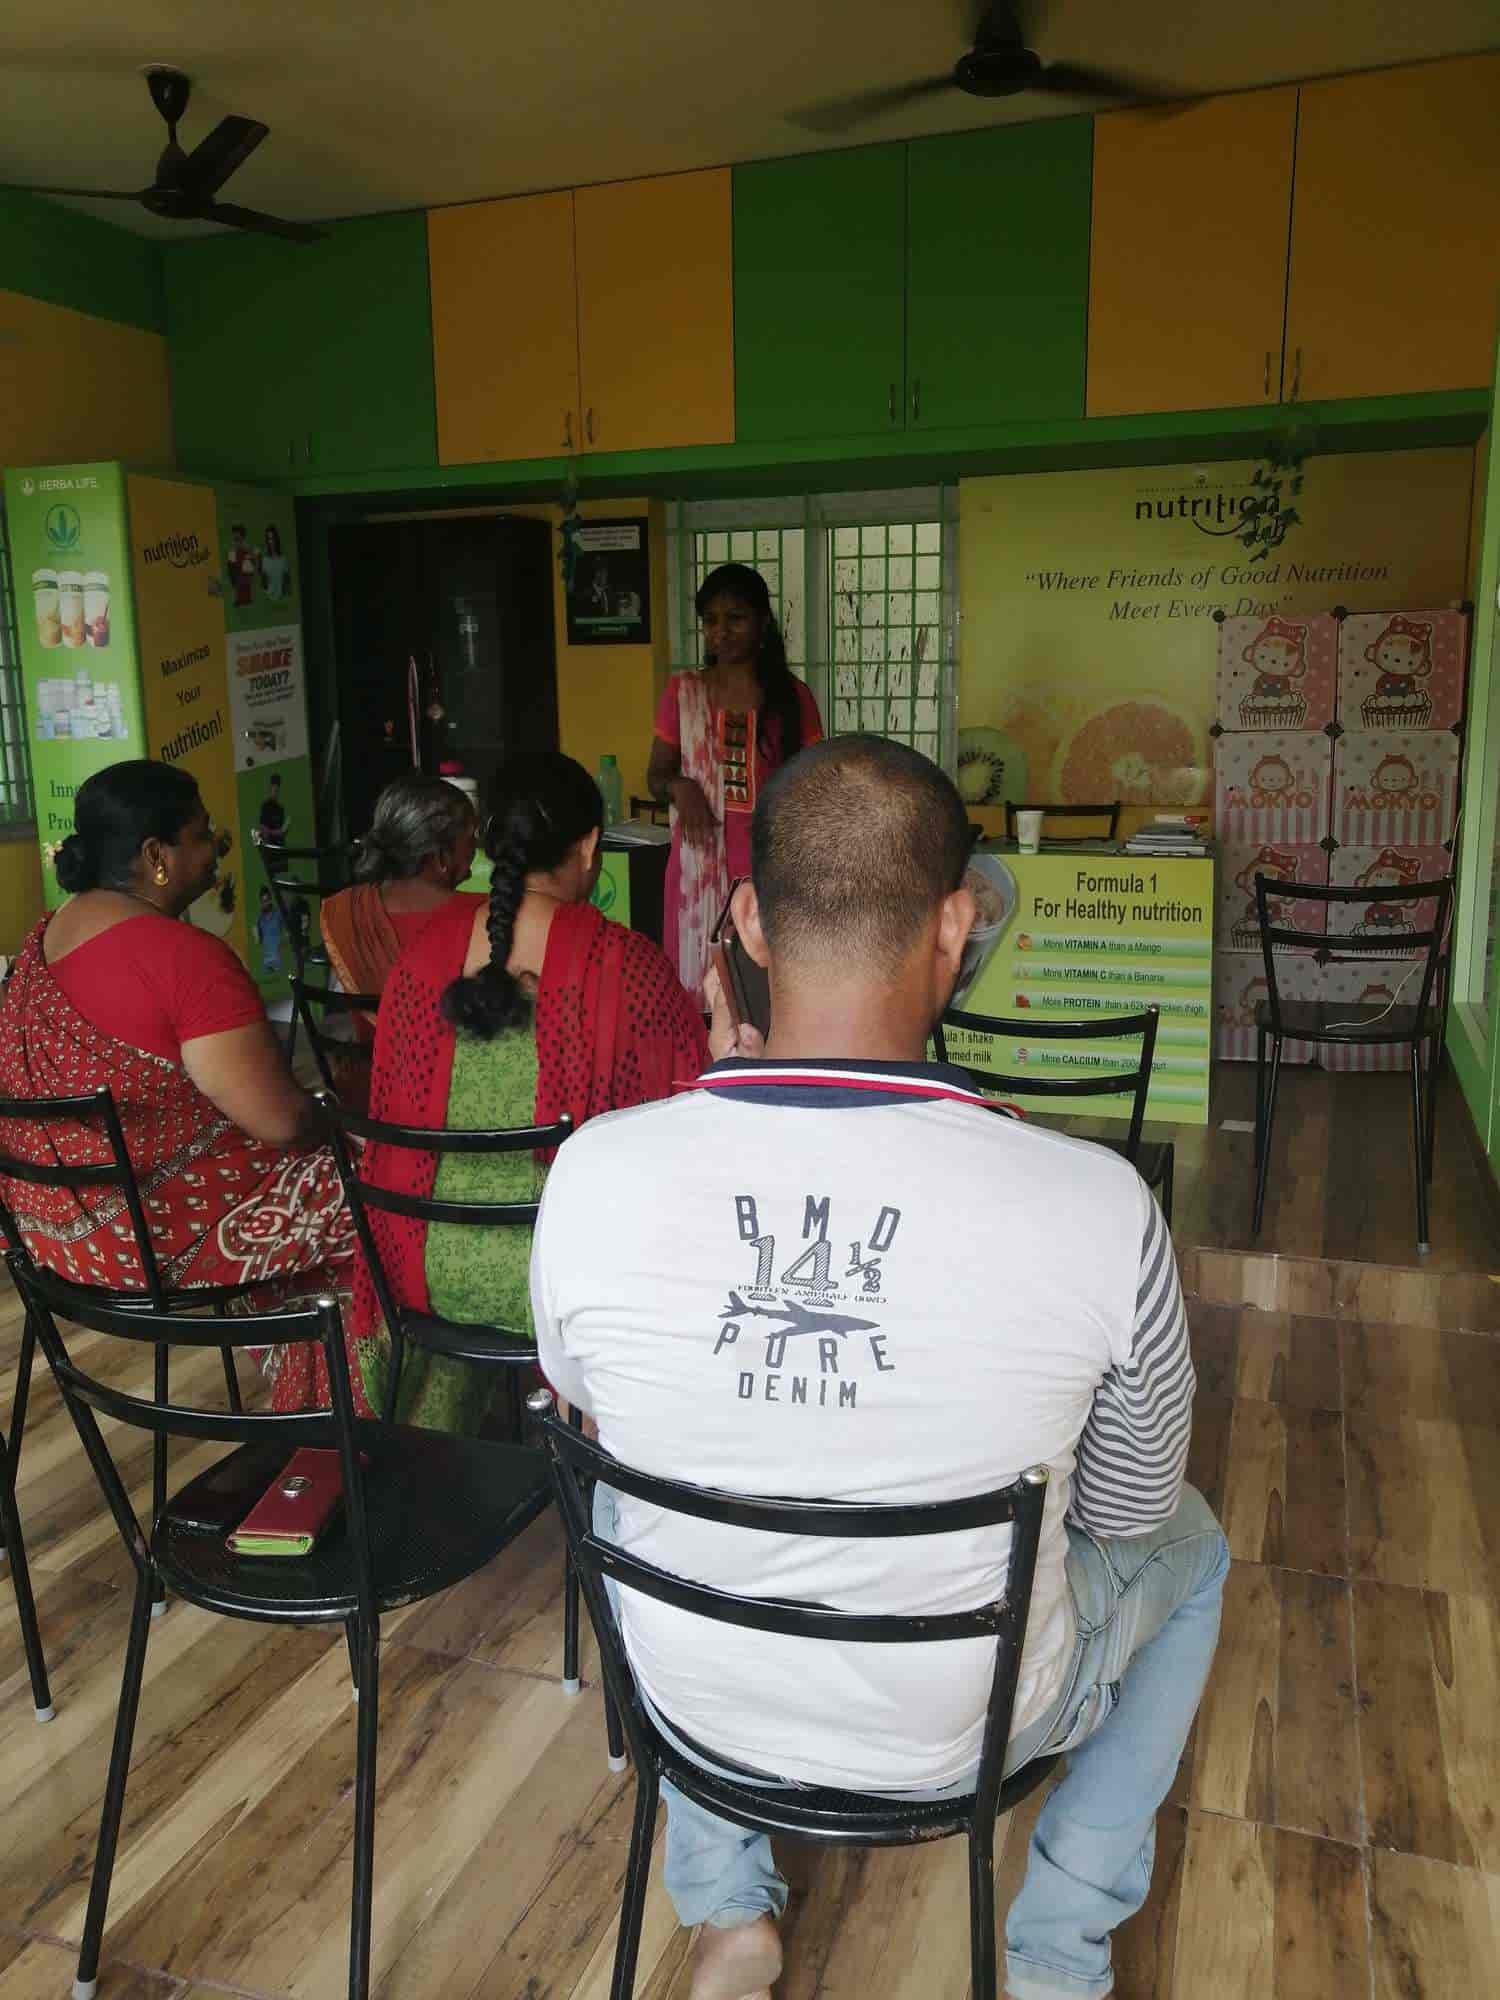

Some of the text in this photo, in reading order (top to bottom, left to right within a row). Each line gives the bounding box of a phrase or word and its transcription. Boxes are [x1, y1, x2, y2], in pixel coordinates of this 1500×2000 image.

[1106, 567, 1185, 589] Friends
[1190, 565, 1216, 589] of
[1220, 563, 1281, 585] Good
[1285, 561, 1391, 585] Nutrition
[1109, 600, 1161, 621] Meet
[176, 685, 201, 707] Your
[160, 709, 224, 763] nutrition!
[47, 812, 73, 831] Pro
[1076, 871, 1157, 893] Formula 1
[1034, 897, 1203, 924] For Healthy nutrition
[1064, 939, 1098, 950] VITAMIN
[1099, 941, 1107, 950] A
[1134, 942, 1162, 954] Mango
[1064, 968, 1098, 980] VITAMIN
[1099, 970, 1107, 981] C
[1063, 997, 1101, 1009] PROTEIN
[974, 1050, 992, 1064] milk
[1062, 1056, 1101, 1066] CALCIUM
[737, 1371, 858, 1409] DENIM
